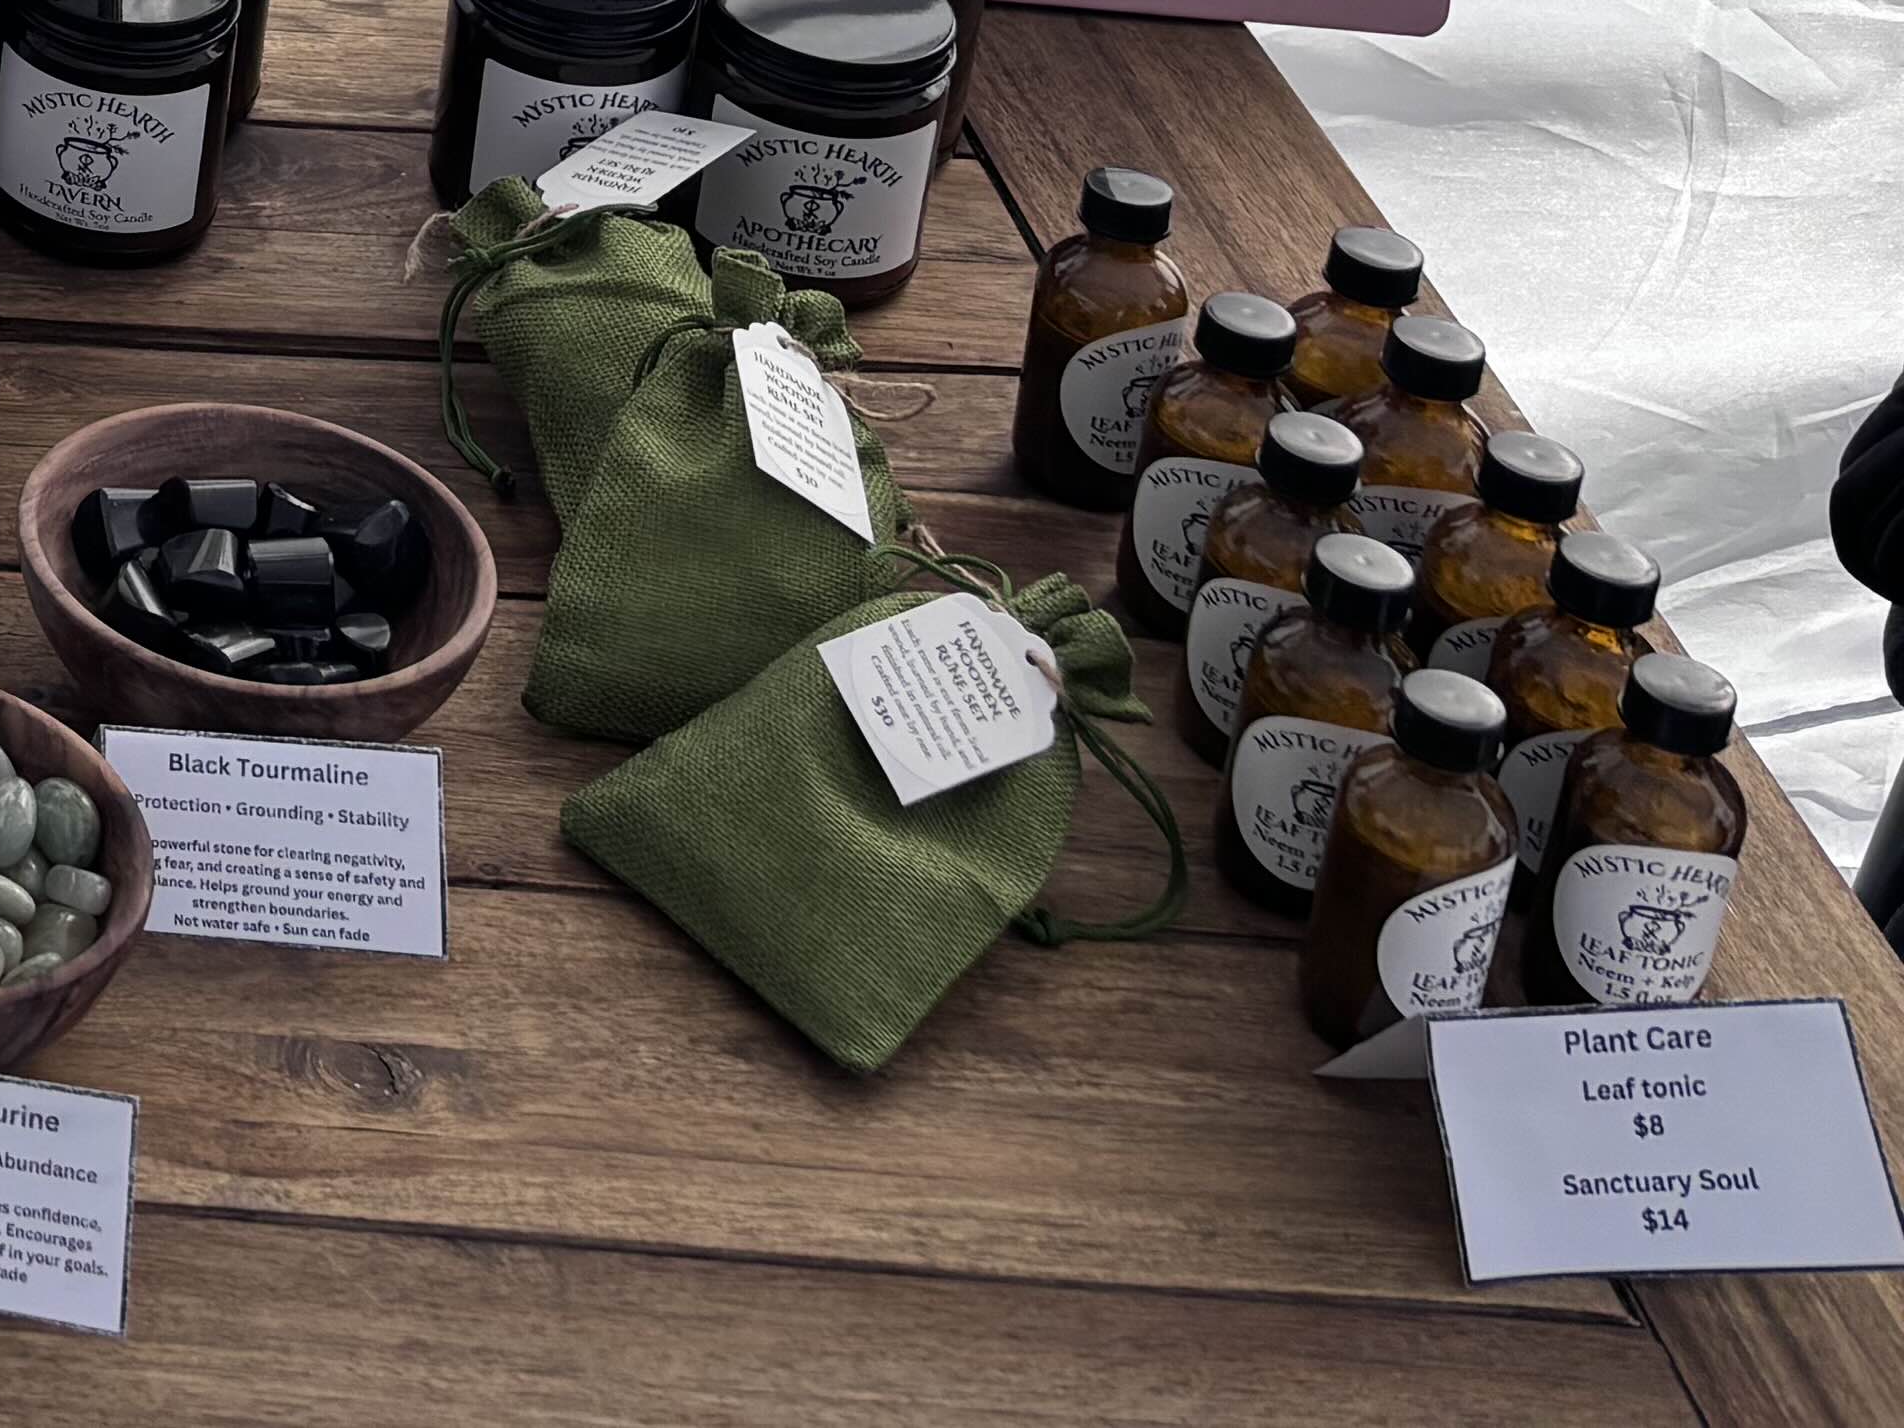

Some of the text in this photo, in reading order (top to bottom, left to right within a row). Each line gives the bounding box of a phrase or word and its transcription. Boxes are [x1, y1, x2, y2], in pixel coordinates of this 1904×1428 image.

[21, 92, 175, 144] MYSTIC HEARTH
[512, 93, 595, 128] MYSTIC
[736, 139, 818, 167] MYSTIC
[824, 143, 903, 187] HEARTH
[46, 179, 124, 212] TAVERN
[736, 215, 882, 255] APOTHECARY
[1078, 336, 1155, 370] MYSTIC
[949, 637, 1001, 720] WOODEN
[958, 621, 1022, 720] HANDMADE
[871, 695, 895, 728] $30
[962, 694, 988, 724] SET
[169, 753, 368, 785] Black Tourmaline
[136, 794, 409, 832] Protection Grounding Stability
[1574, 856, 1665, 878] MYSTIC
[1579, 932, 1705, 971] LEAF TONIC
[1578, 952, 1635, 986] Neem
[1565, 1026, 1711, 1055] Plant Care
[1583, 1074, 1706, 1101] Leaf tonic
[1633, 1112, 1664, 1139] $8
[1563, 1167, 1760, 1198] Sanctuary Soul
[1642, 1207, 1689, 1234] $14
